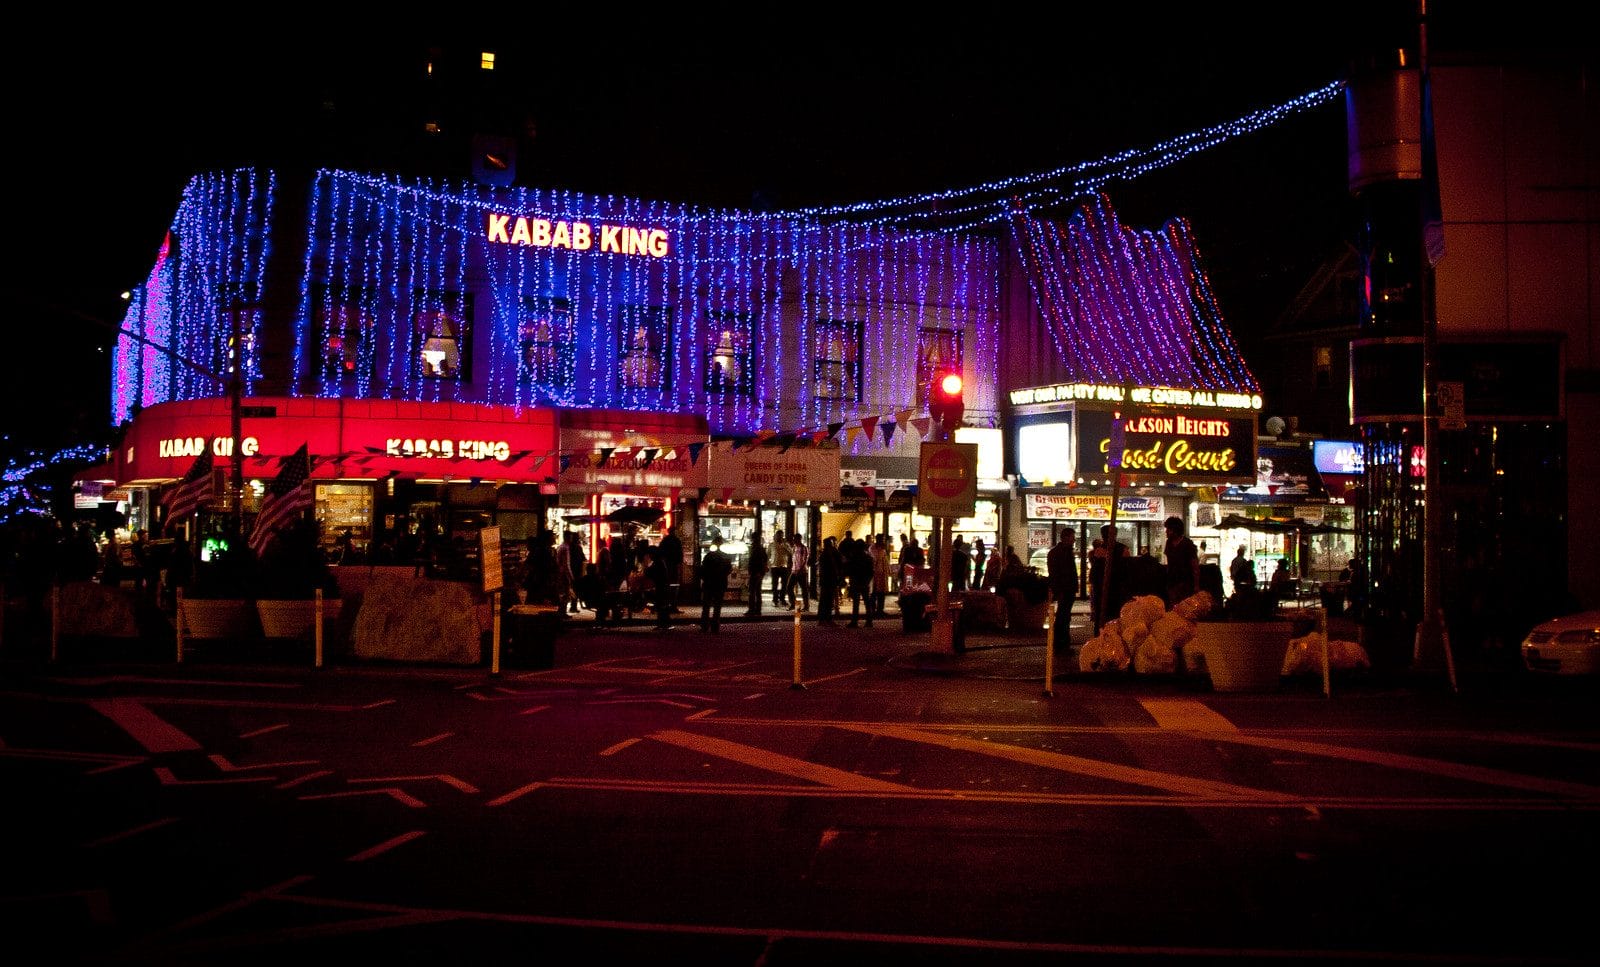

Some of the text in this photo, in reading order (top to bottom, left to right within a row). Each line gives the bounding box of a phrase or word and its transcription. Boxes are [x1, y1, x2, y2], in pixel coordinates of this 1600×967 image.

[488, 213, 668, 258] KABAB KING
[1097, 385, 1125, 401] HAL
[1131, 388, 1151, 402] WE
[1152, 389, 1192, 405] CATER
[1193, 391, 1216, 406] ALL
[1125, 416, 1230, 437] CKSON HEIGHTS
[213, 437, 259, 456] KIG
[386, 439, 510, 461] KABAB KING
[1165, 440, 1236, 474] Court
[744, 473, 807, 484] CANDY STORE
[934, 481, 958, 490] ENTER
[1035, 495, 1112, 506] Grand Opening
[1117, 497, 1149, 510] Special
